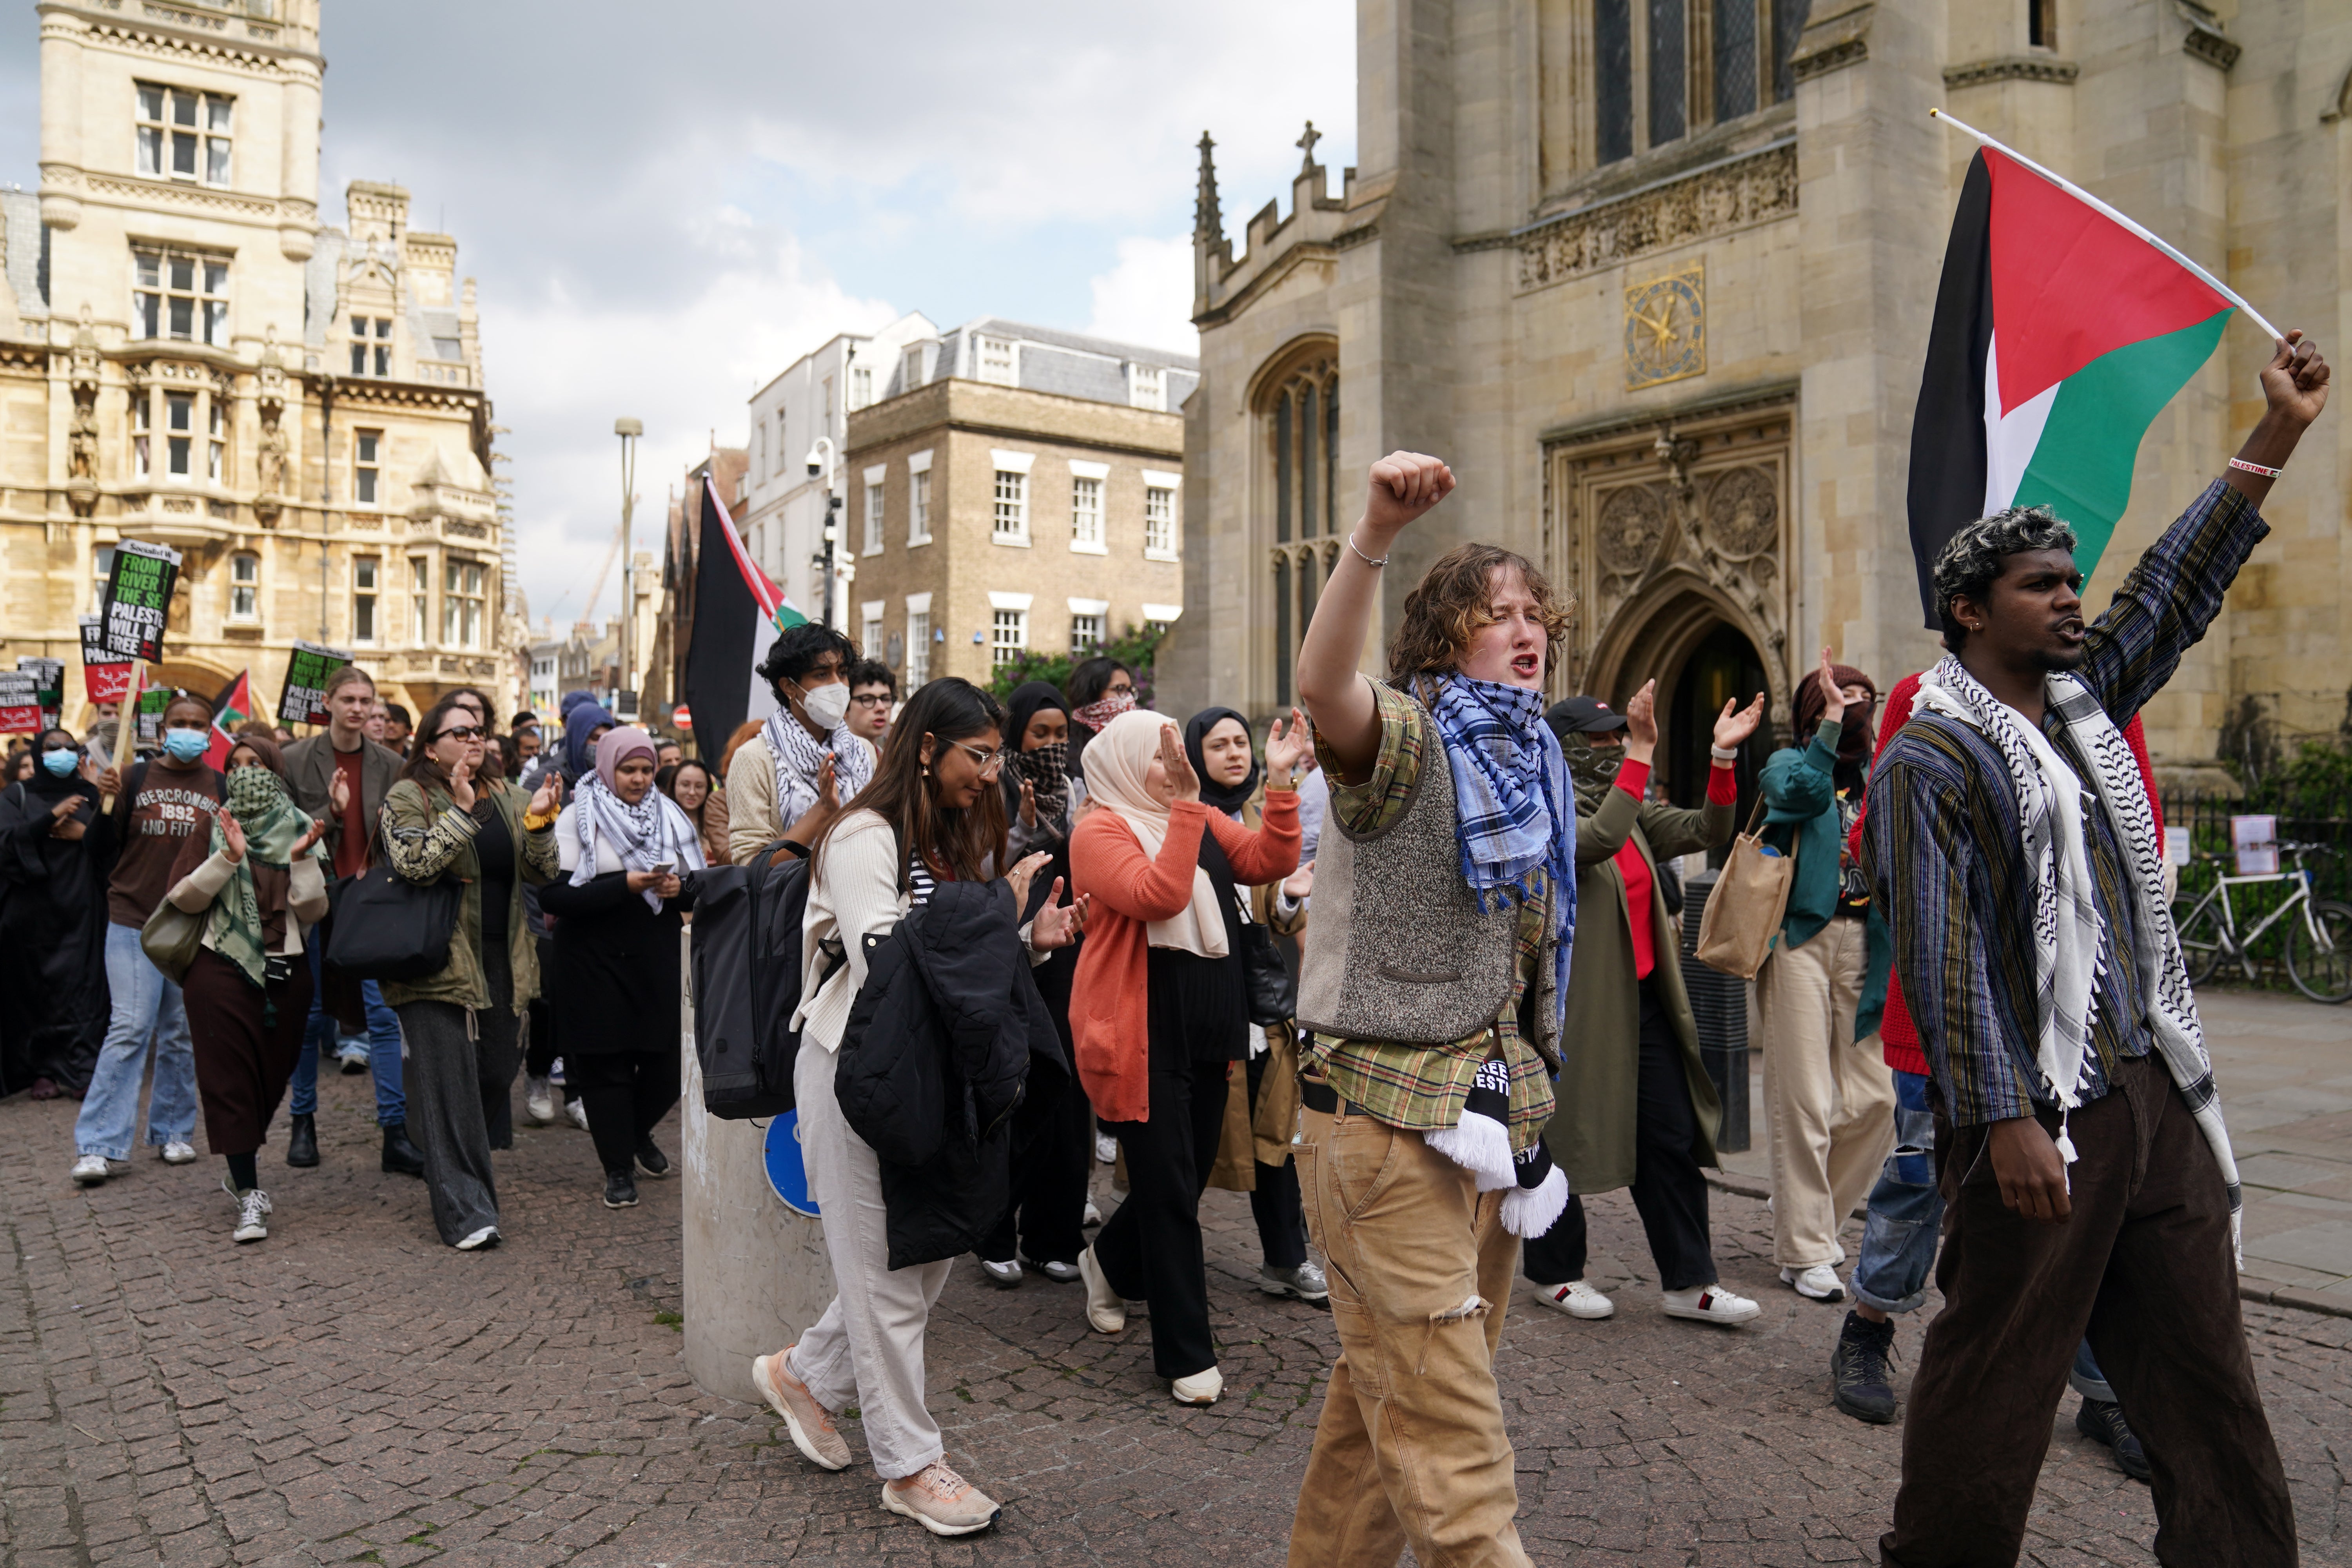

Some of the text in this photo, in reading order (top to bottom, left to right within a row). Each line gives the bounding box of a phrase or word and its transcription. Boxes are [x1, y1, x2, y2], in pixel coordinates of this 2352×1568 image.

[2230, 460, 2269, 475] PALESTINE
[122, 553, 162, 576] FROM
[118, 570, 159, 592] RIVER
[116, 585, 143, 606] THE
[109, 617, 141, 639] WILL
[107, 633, 140, 655] FREE
[282, 706, 307, 722] FREE
[285, 696, 309, 711] WILL
[135, 788, 219, 816] ABERCROMBIE
[159, 802, 196, 822] 1892
[142, 818, 166, 835] AND
